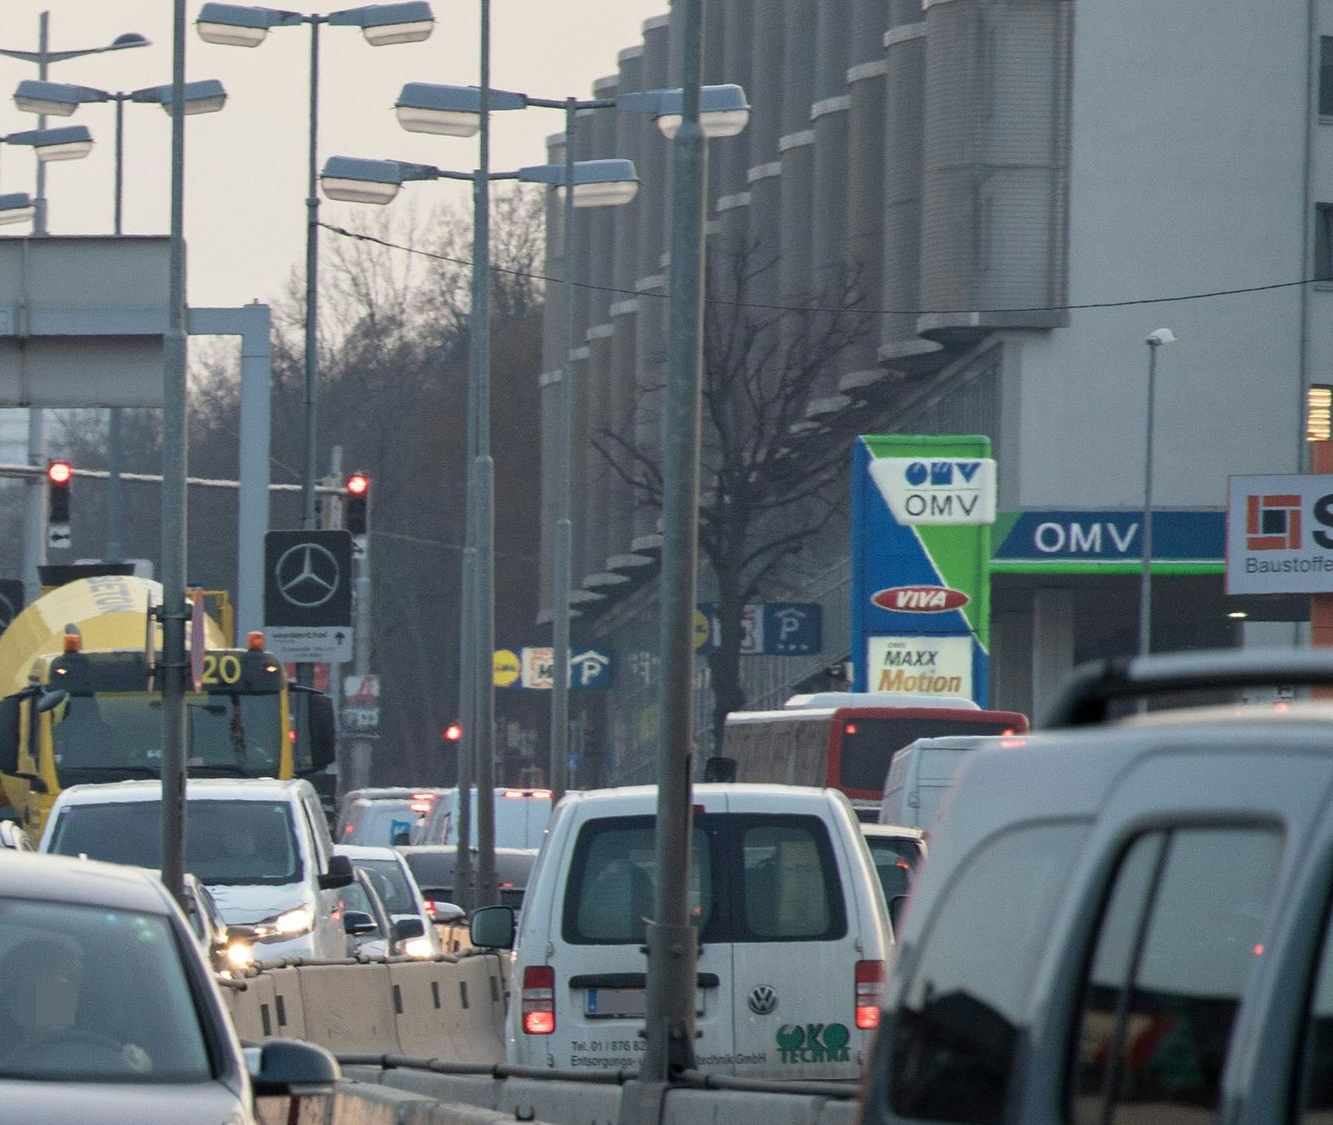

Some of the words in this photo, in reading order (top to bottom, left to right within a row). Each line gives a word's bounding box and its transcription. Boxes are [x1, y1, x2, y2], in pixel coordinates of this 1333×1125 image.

[905, 493, 980, 517] OMV
[1034, 521, 1140, 553] OMV
[1245, 556, 1333, 574] Baustoffe
[896, 590, 948, 608] VIVA
[884, 651, 940, 667] MAXX
[878, 668, 962, 693] Motion
[570, 1055, 635, 1068] Entsorgungs-
[736, 1053, 767, 1065] GmbH
